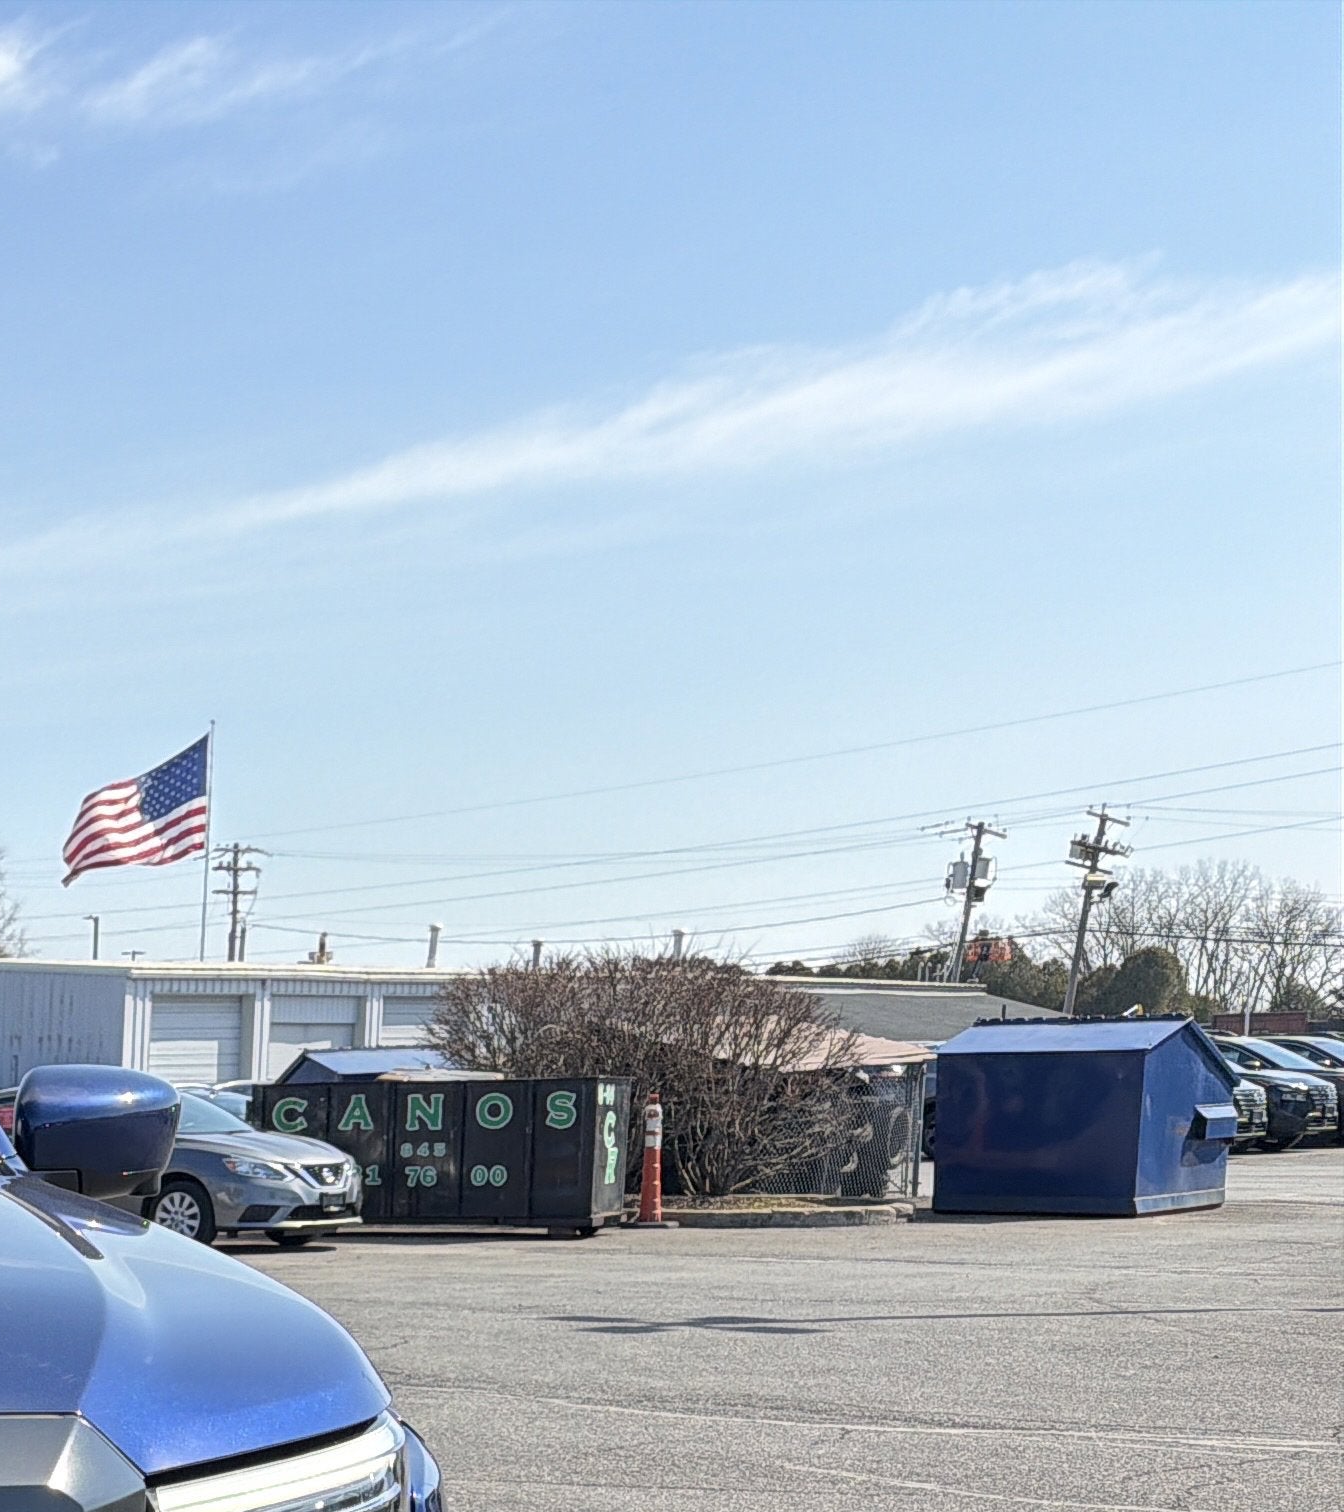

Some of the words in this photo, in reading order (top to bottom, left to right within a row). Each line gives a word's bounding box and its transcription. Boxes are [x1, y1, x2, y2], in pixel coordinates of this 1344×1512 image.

[272, 1091, 577, 1133] CANOS
[405, 1165, 437, 1187] 76
[471, 1165, 507, 1187] 00
